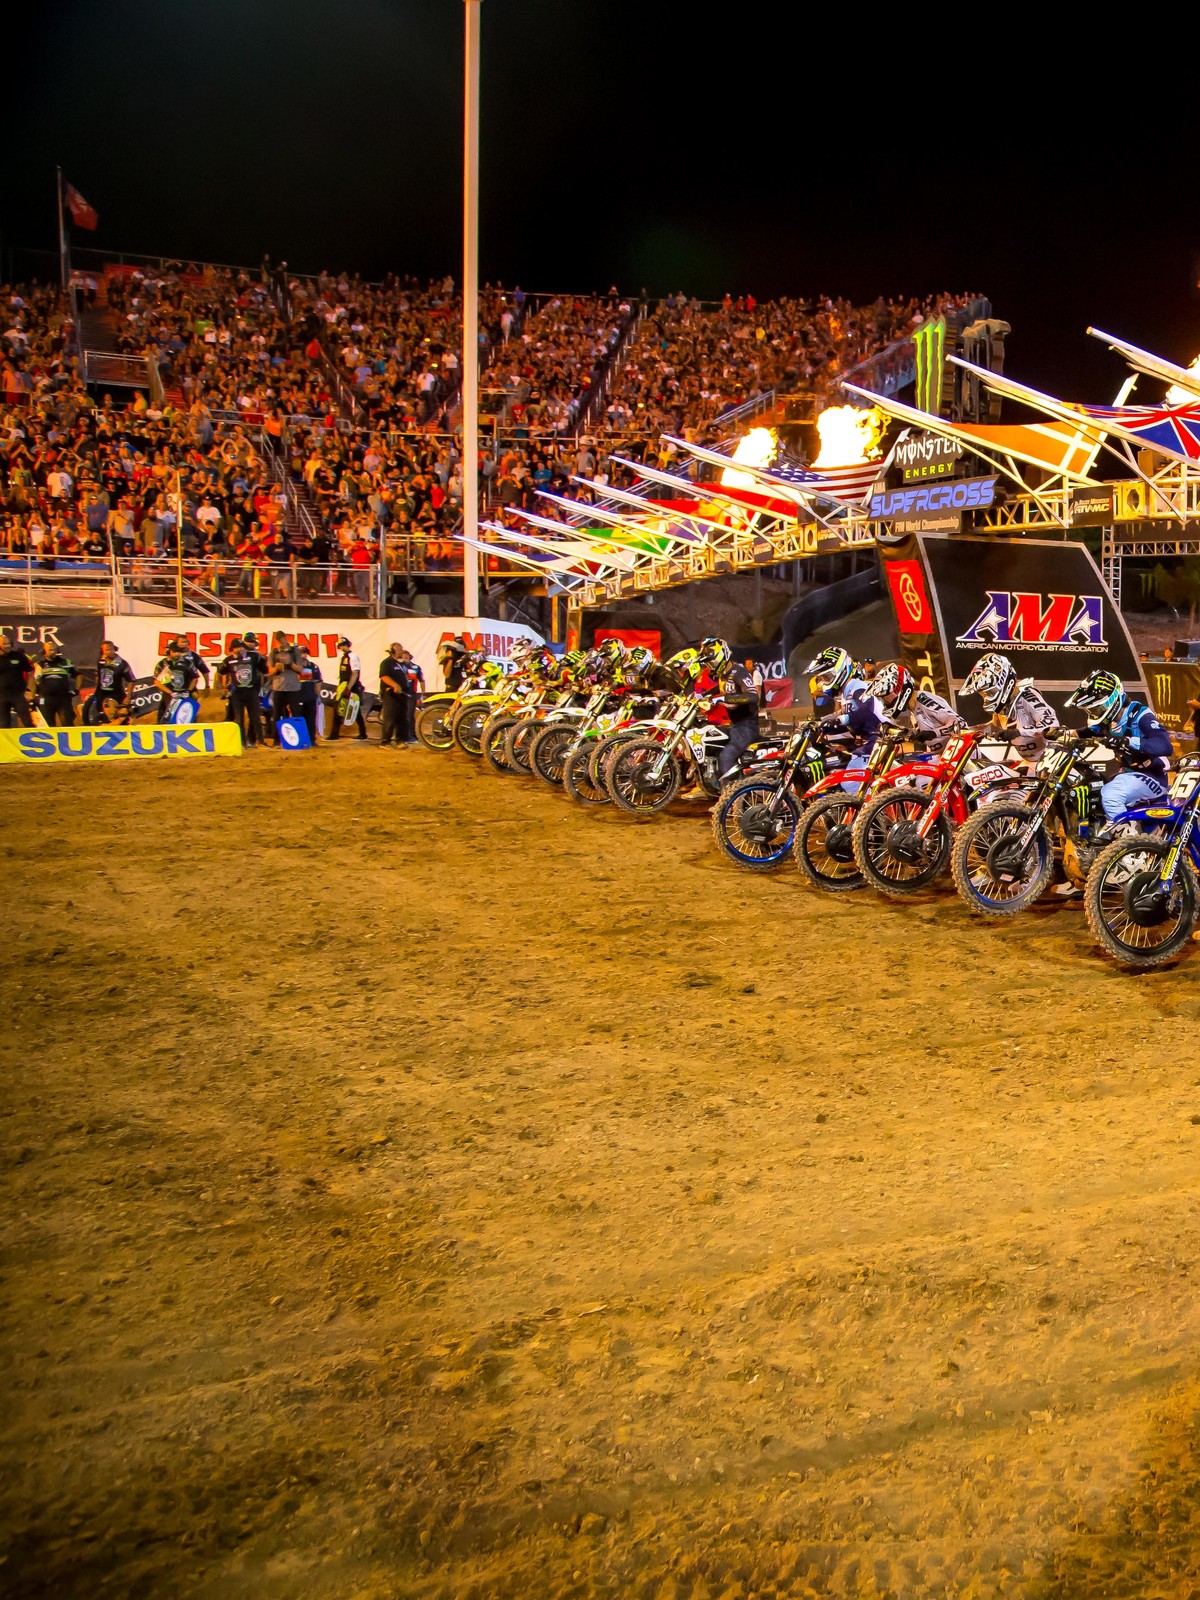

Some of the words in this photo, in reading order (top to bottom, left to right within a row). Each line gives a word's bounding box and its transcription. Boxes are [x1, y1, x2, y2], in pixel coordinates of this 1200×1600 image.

[905, 462, 953, 478] ENERGY
[870, 479, 997, 518] SUPERCROSS
[956, 591, 1108, 645] AMA
[956, 642, 999, 650] AMERICAN
[998, 643, 1059, 652] MOTORCYCLIST
[1058, 645, 1109, 653] ASSOCIATION
[1001, 679, 1014, 703] GEICO
[19, 728, 215, 759] SUZUKI
[971, 769, 1004, 786] GEICO
[1133, 773, 1163, 795] THOR
